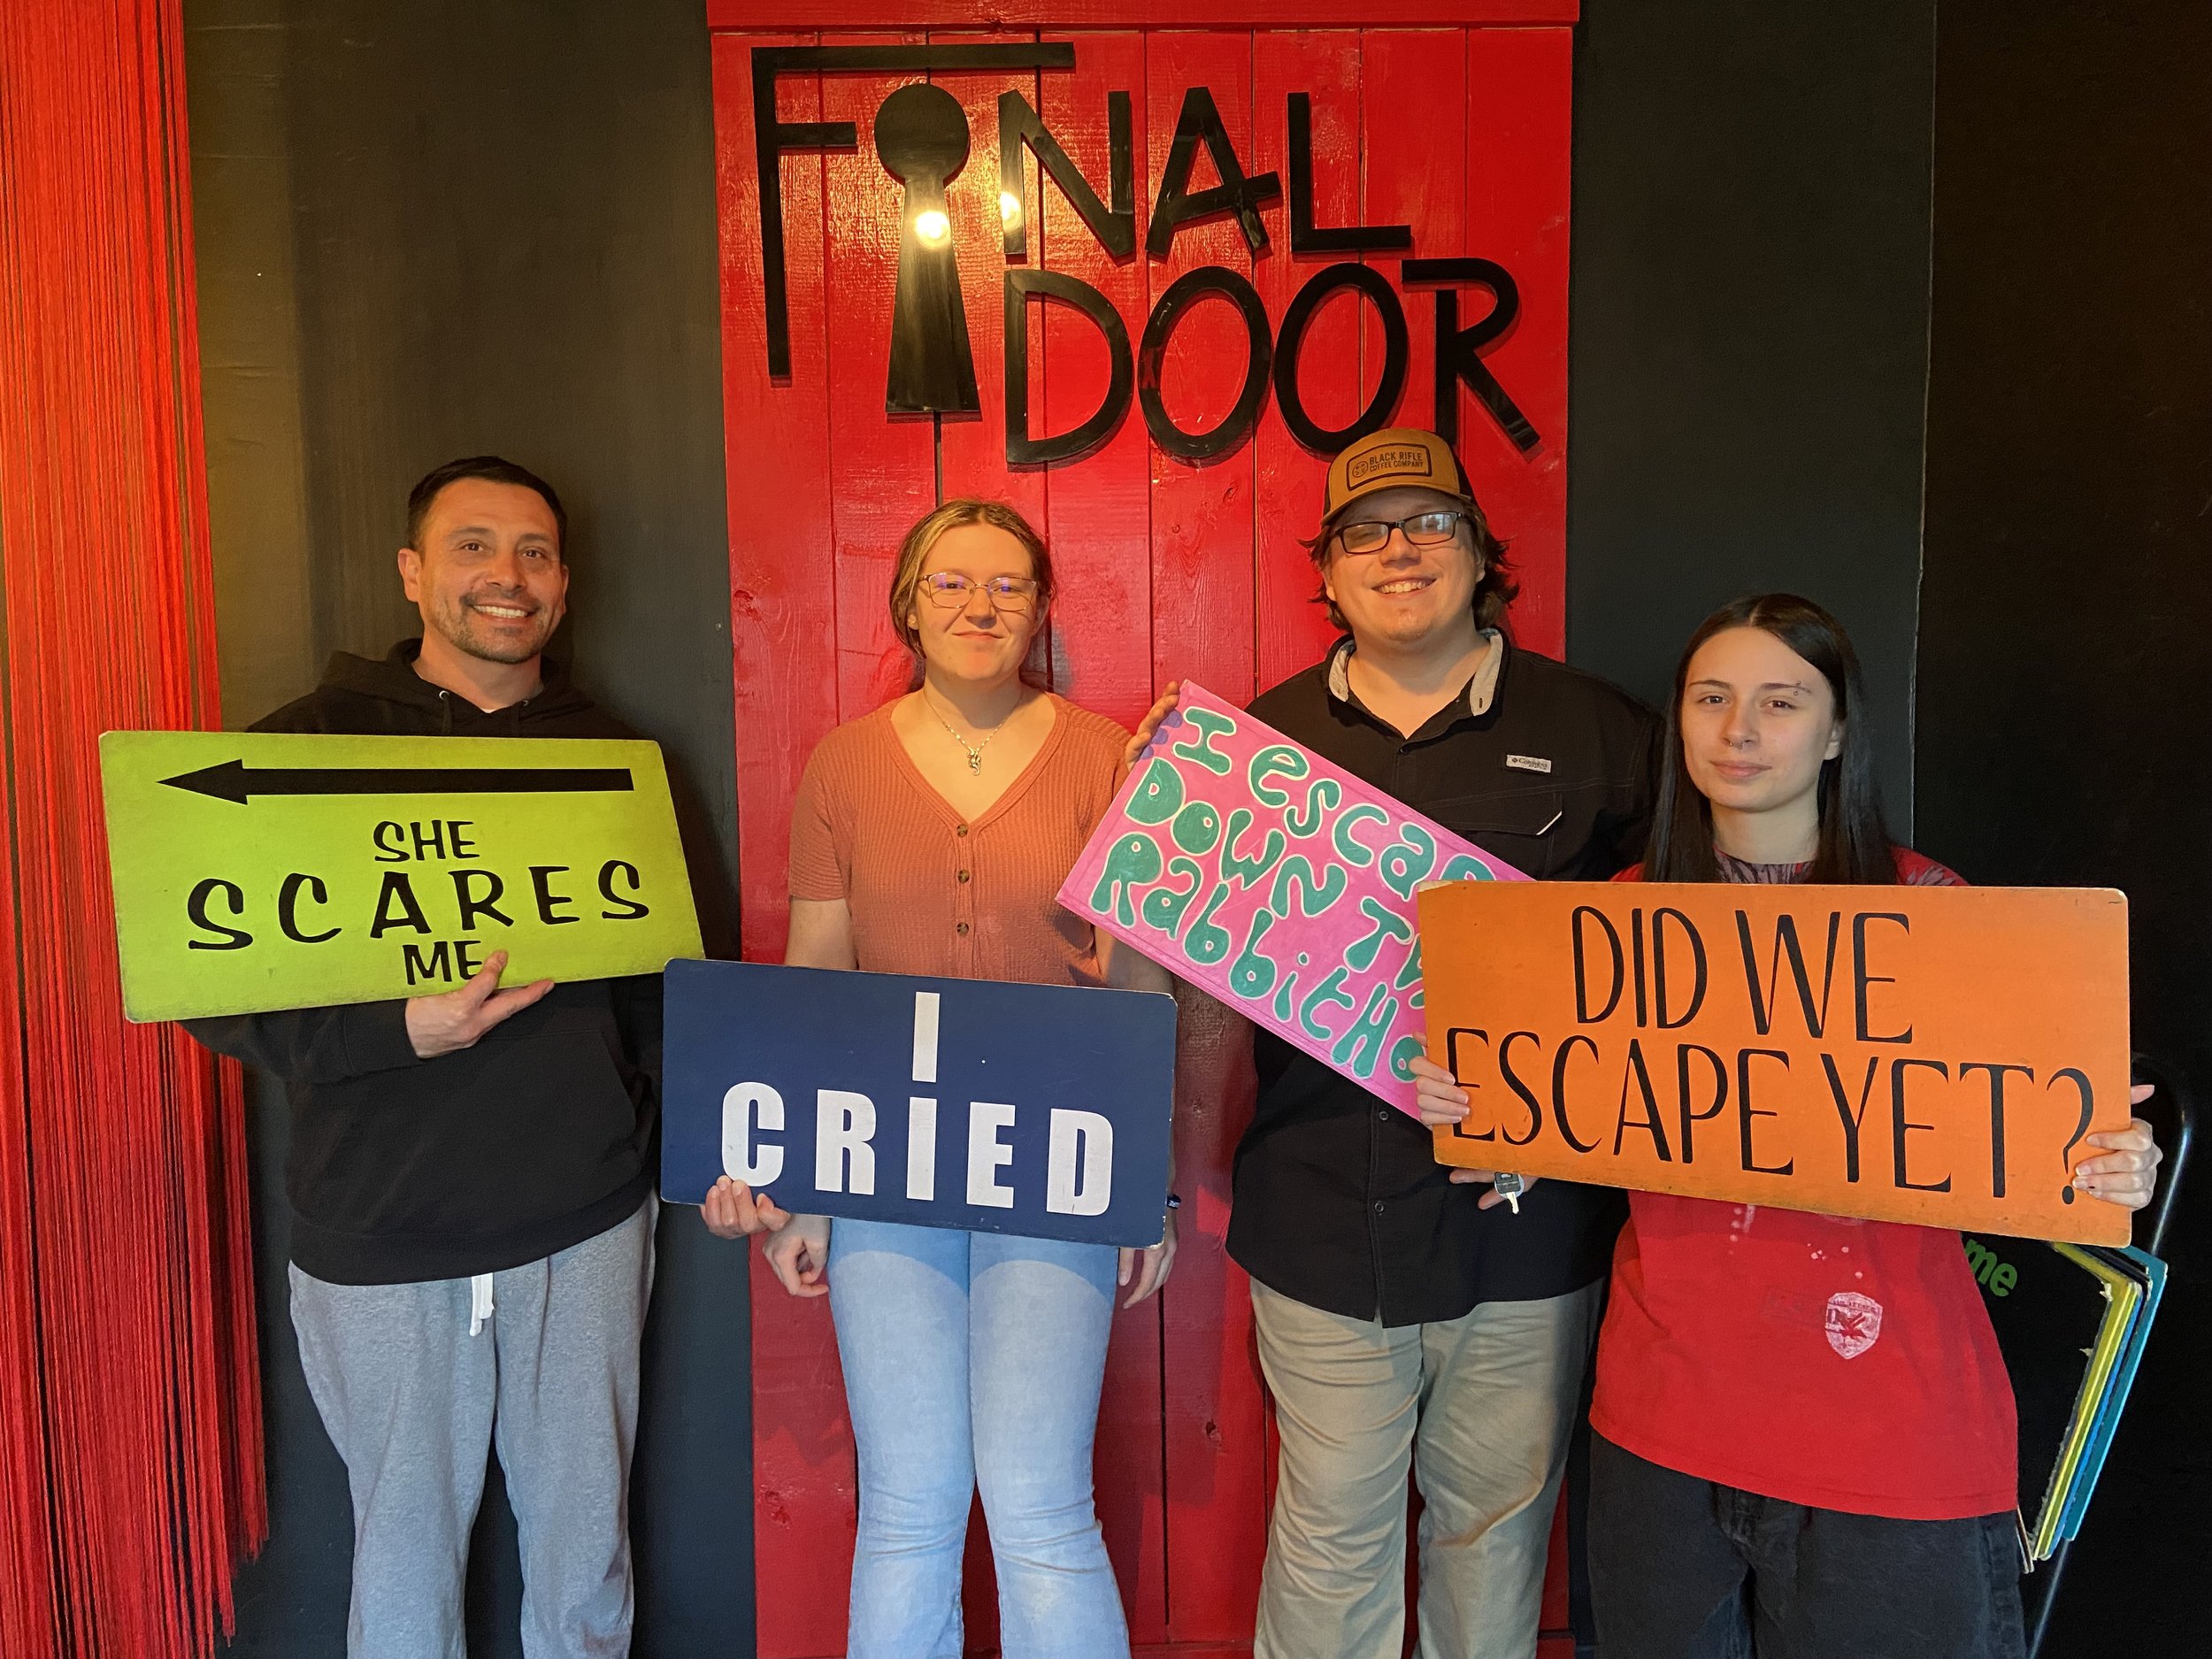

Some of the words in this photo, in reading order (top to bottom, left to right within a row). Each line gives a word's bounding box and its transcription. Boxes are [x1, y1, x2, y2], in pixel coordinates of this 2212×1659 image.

[1003, 258, 1540, 468] DOOR
[1369, 452, 1395, 465] BLACK
[1399, 451, 1423, 461] RIFLE
[1369, 462, 1392, 472] COFFEE
[1171, 706, 1238, 776] I
[373, 819, 480, 862] SHE
[188, 859, 650, 951] SCARES
[402, 940, 483, 986] ME
[1571, 905, 1709, 1031] DID
[1735, 910, 1913, 1045] WE
[911, 991, 941, 1083] I
[721, 1081, 1114, 1217] CRIED
[1446, 1027, 1794, 1177] ESCAPE
[1819, 1052, 2095, 1206] YET?
